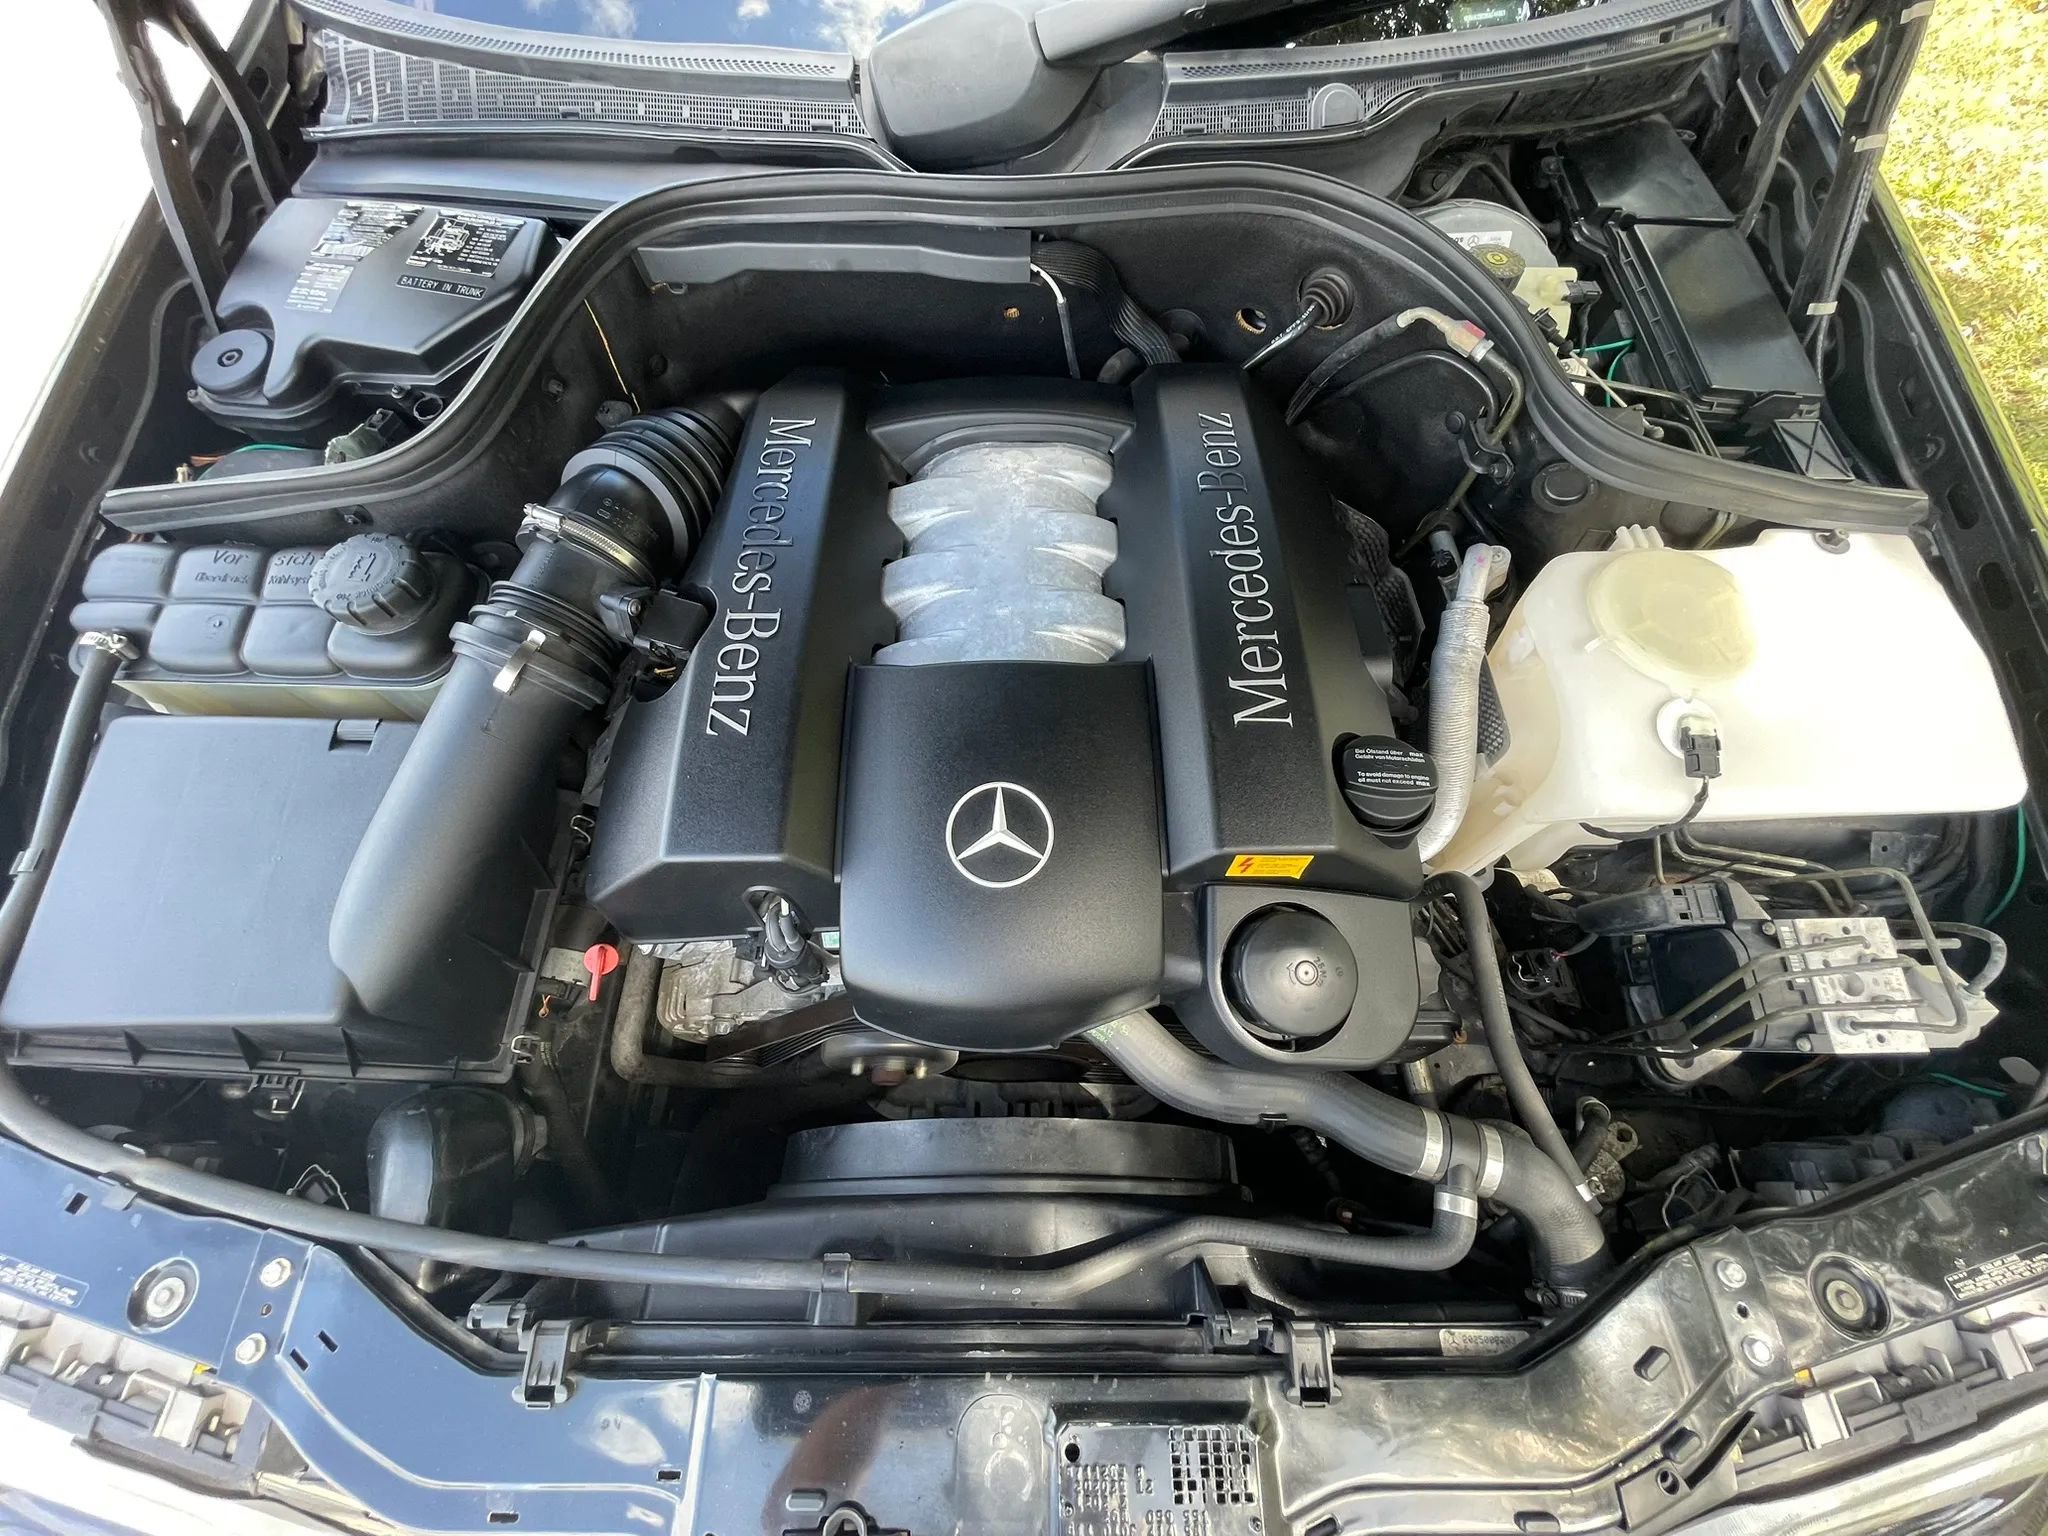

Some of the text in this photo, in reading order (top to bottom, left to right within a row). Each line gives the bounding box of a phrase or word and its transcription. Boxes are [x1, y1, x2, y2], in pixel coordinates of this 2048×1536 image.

[401, 276, 485, 297] BATTERY IN TRUNK
[706, 416, 817, 736] Mercedes-Benz
[1197, 411, 1294, 728] Mercedes-Benz
